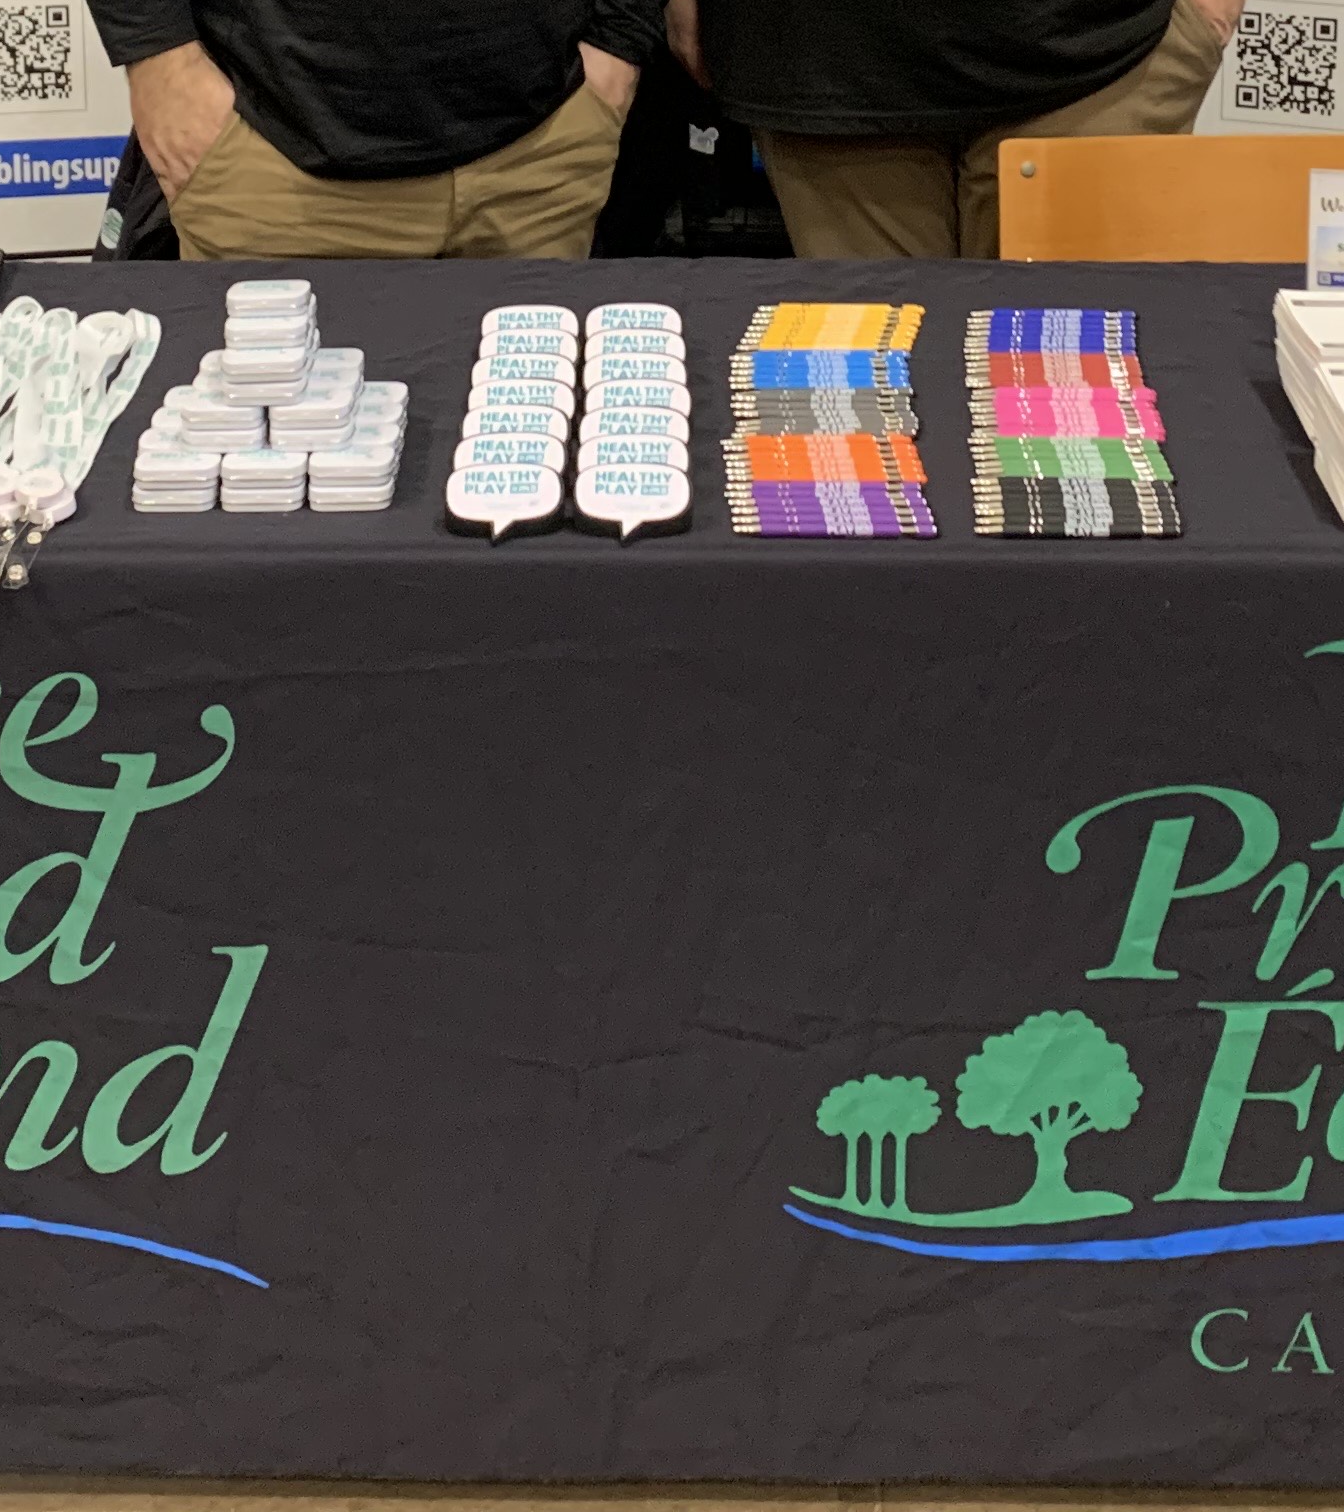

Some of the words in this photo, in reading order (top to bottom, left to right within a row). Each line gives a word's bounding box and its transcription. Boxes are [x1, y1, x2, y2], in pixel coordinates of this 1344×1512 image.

[498, 312, 563, 322] HEALTHY
[602, 309, 667, 321] HEALTHY
[601, 319, 637, 328] PLAY
[497, 335, 563, 345] HEALTHY
[603, 336, 670, 345] HEALTHY
[489, 358, 558, 368] HEALTHY
[602, 360, 670, 370] HEALTHY
[489, 369, 527, 379] PLAY
[601, 370, 638, 379] PLAY
[487, 386, 557, 396] HEALTHY
[603, 387, 674, 398] HEALTHY
[603, 398, 641, 407] PLAY
[480, 412, 553, 422] HEALTHY
[600, 412, 672, 424] HEALTHY
[479, 424, 518, 433] PLAY
[599, 424, 638, 435] PLAY
[473, 440, 549, 451] HEALTHY
[597, 442, 672, 453] HEALTHY
[473, 452, 515, 463] PLAY
[597, 454, 637, 465] PLAY
[464, 471, 541, 482] HEALTHY
[595, 471, 673, 483] HEALTHY
[464, 483, 505, 494] PLAY
[595, 484, 637, 495] PLAY
